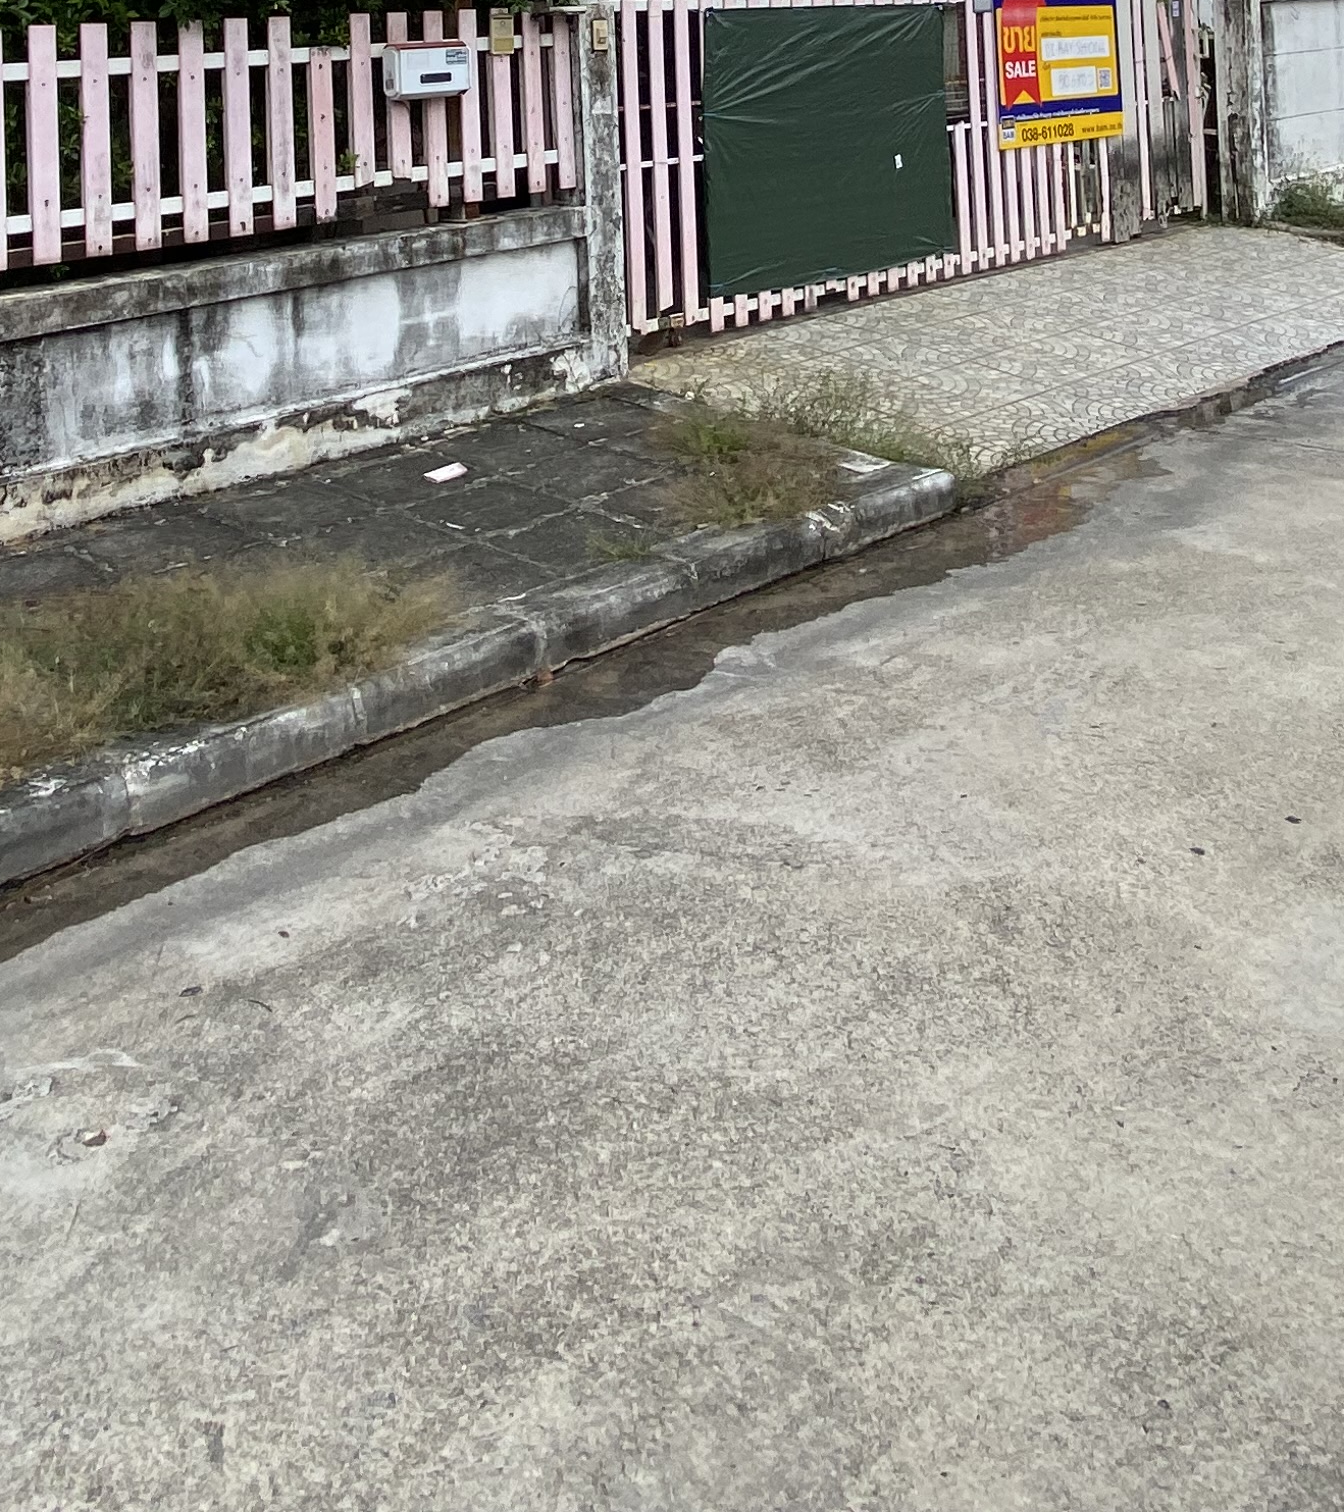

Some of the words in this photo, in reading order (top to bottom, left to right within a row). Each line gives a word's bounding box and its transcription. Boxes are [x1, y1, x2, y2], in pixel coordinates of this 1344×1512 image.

[1003, 25, 1035, 53] ขาย
[1005, 60, 1036, 79] SALE
[1021, 123, 1075, 143] 038-611028
